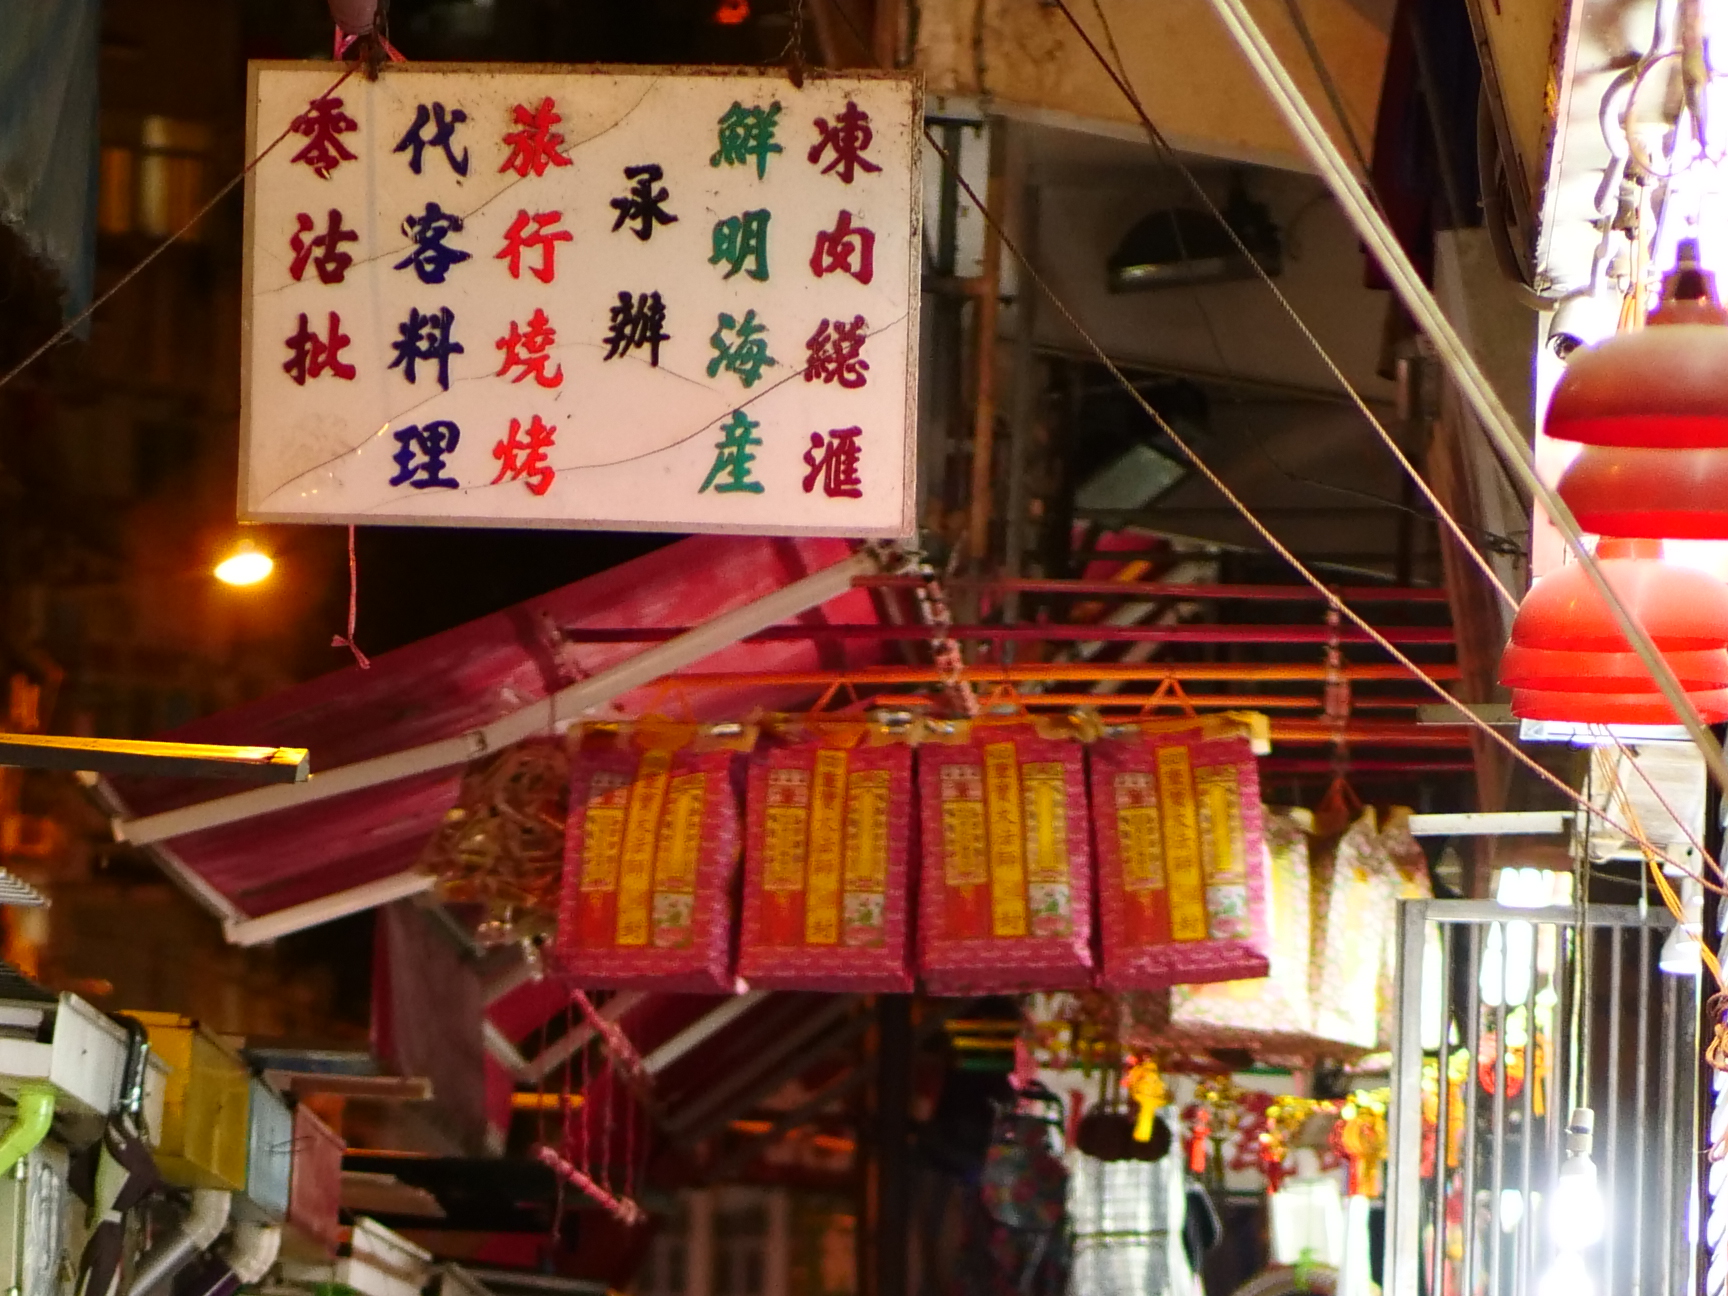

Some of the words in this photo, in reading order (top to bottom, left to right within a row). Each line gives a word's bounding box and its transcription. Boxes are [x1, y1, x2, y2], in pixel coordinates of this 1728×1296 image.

[387, 100, 473, 489] 代客料理
[490, 96, 574, 496] 旅行燒烤
[602, 163, 679, 367] 承辦
